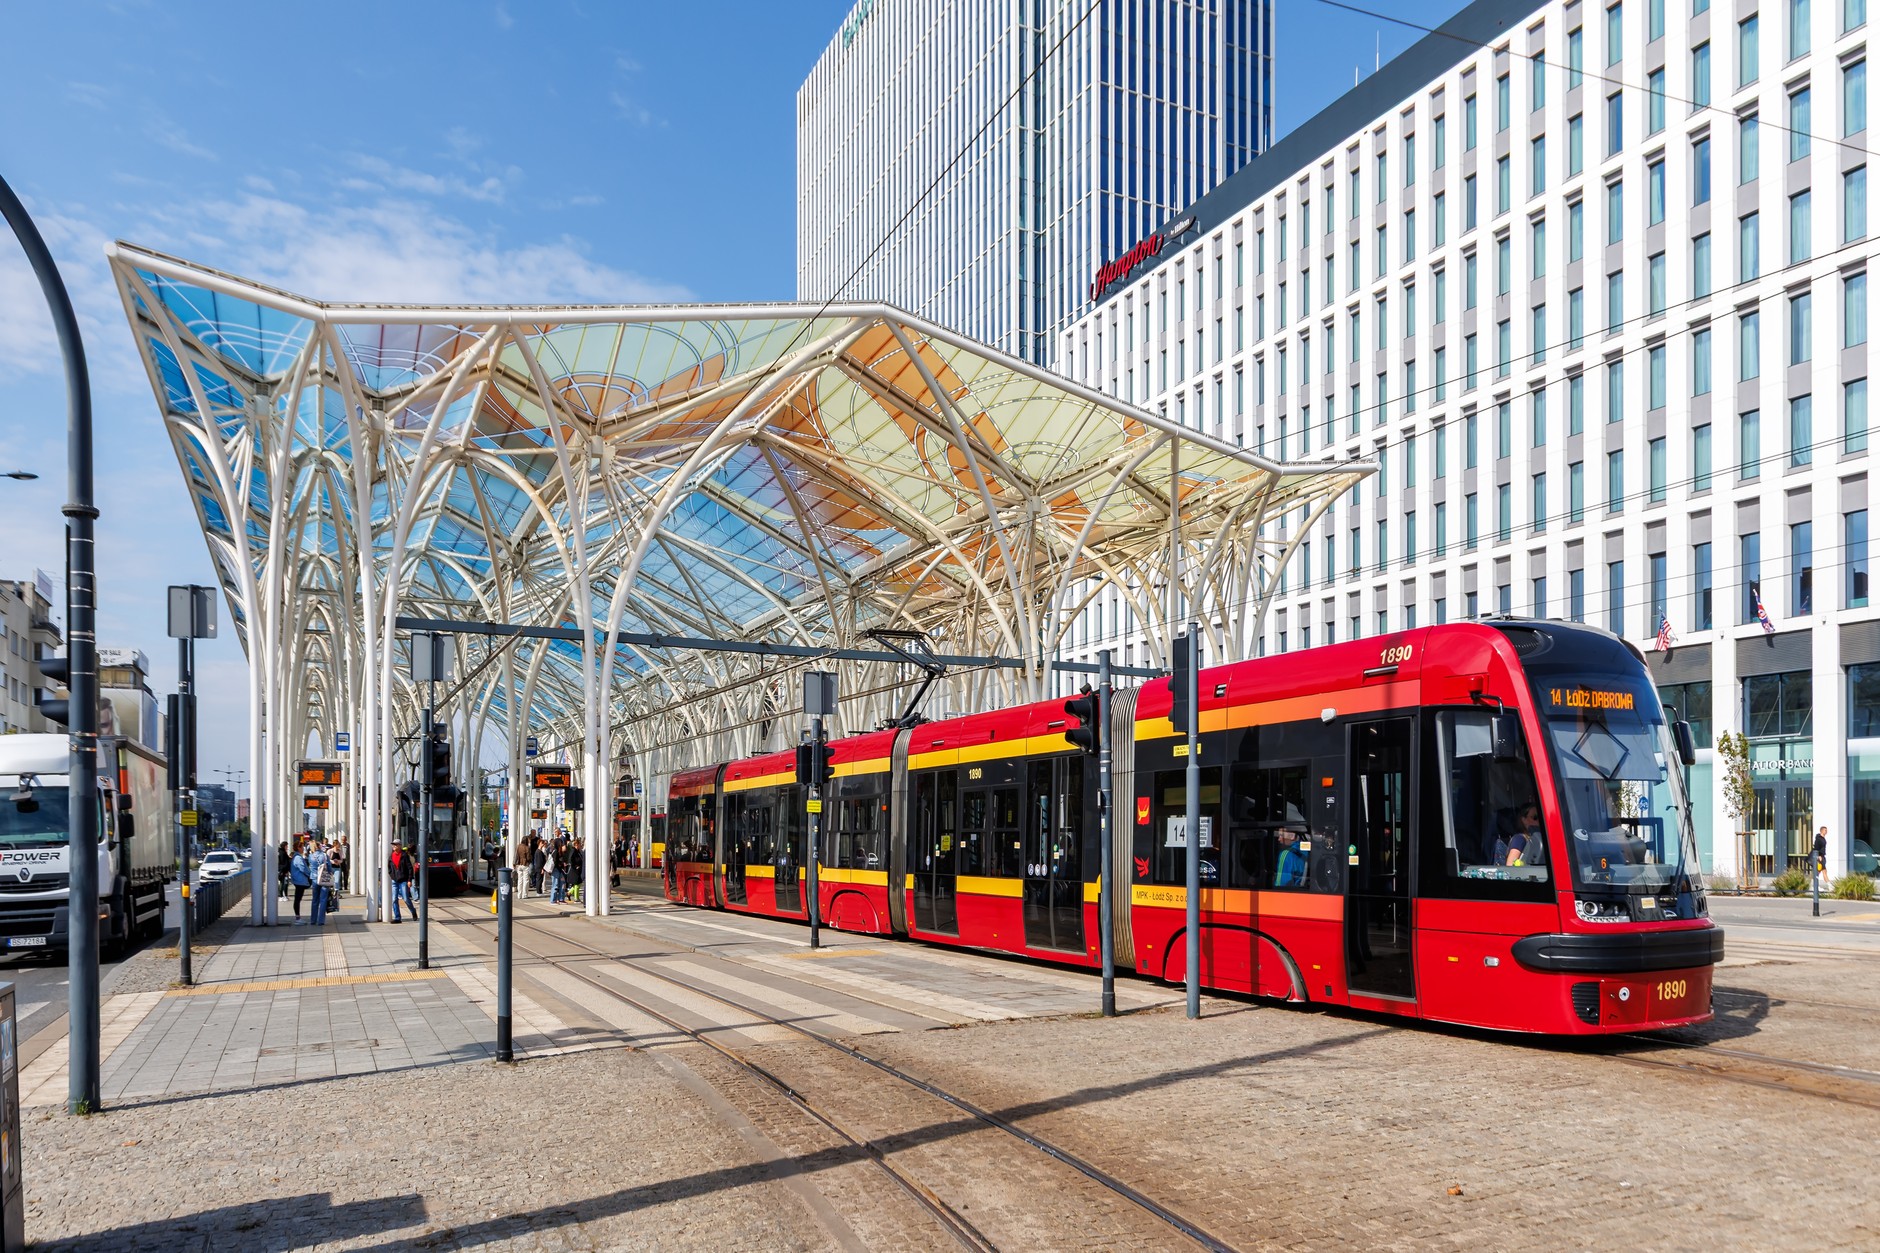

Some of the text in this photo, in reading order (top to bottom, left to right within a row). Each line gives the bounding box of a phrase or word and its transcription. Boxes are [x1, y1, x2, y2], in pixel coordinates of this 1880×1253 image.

[1090, 234, 1163, 301] Hampton
[1174, 218, 1190, 234] Hilton
[1380, 644, 1413, 665] 1890
[1550, 689, 1561, 705] 14
[1566, 689, 1590, 707] ŁÓDŹ
[1752, 760, 1785, 770] ALIOR
[969, 767, 982, 780] 1890
[1174, 825, 1185, 841] 14
[0, 852, 61, 861] POWER
[1601, 858, 1607, 869] 6
[1136, 890, 1149, 900] MPK
[1657, 979, 1687, 1001] 1890
